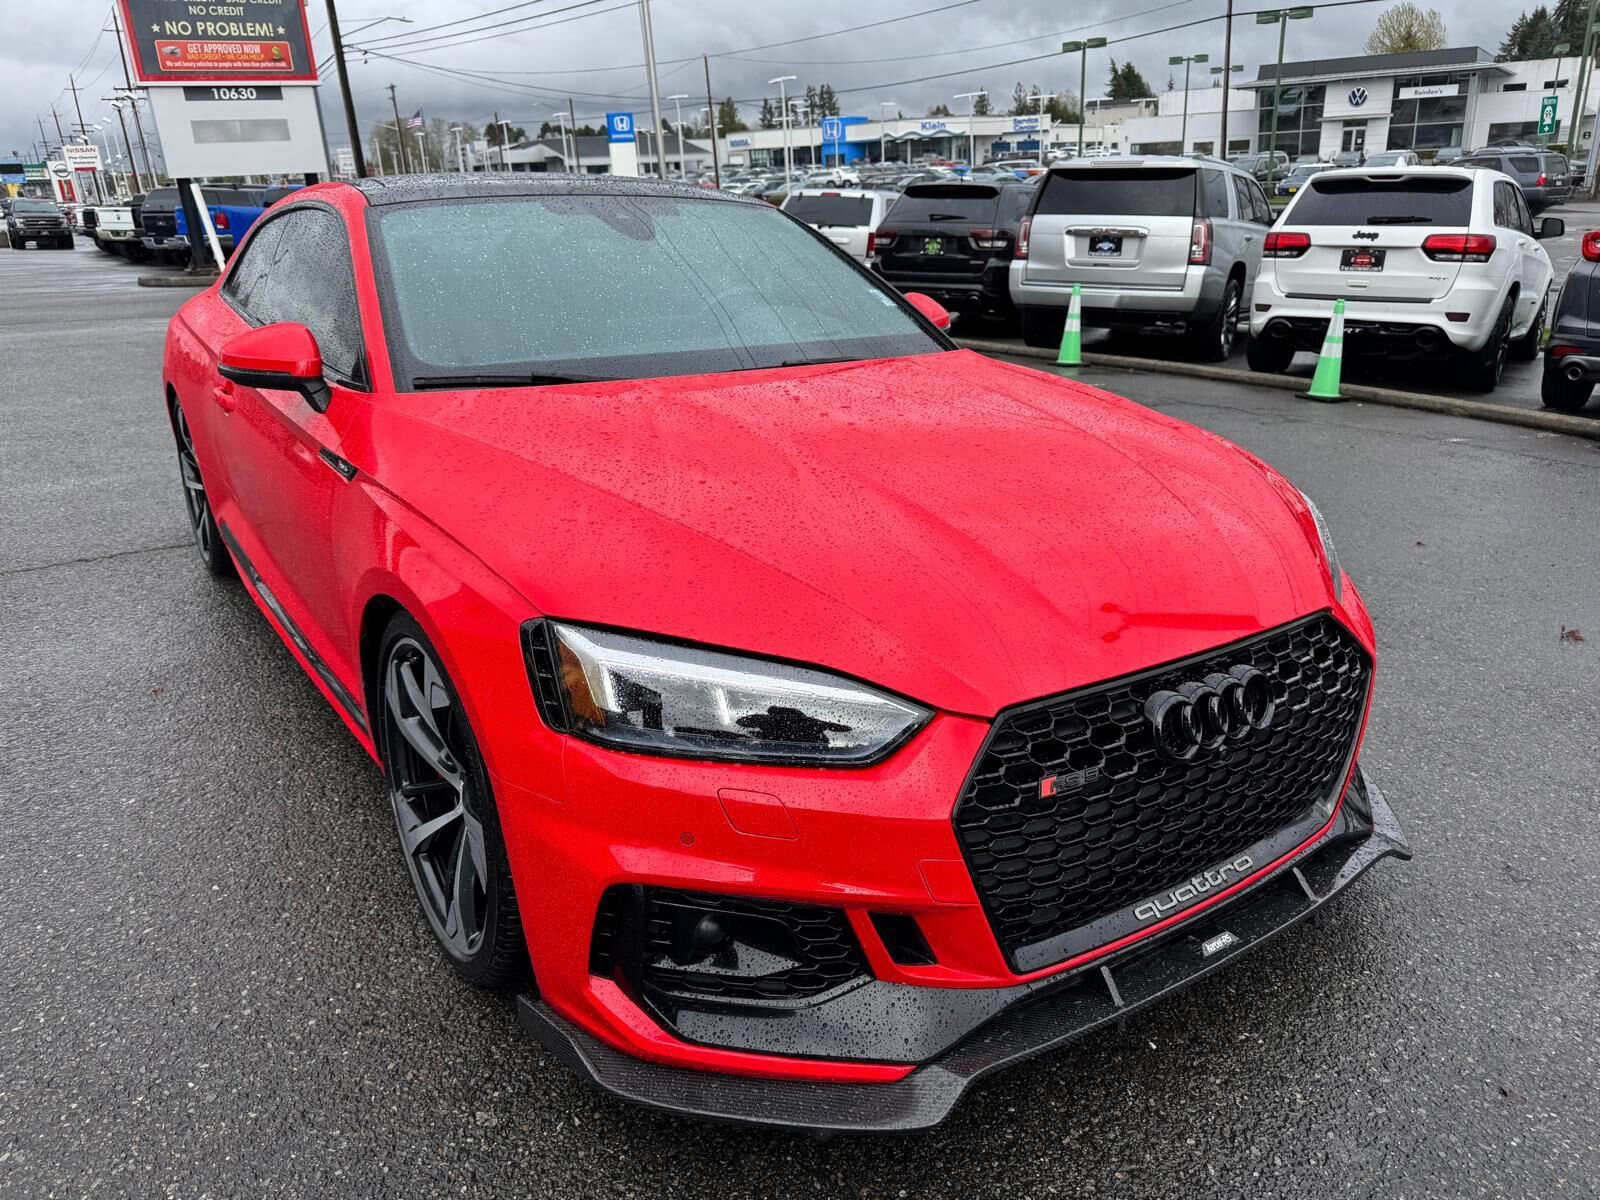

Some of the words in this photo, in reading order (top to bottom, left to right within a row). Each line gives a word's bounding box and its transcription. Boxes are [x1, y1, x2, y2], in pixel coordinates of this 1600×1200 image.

[188, 6, 206, 15] NO
[209, 6, 244, 16] CREDIT
[164, 21, 192, 35] NO
[196, 22, 274, 36] PROBLEM!
[187, 43, 202, 54] GET
[203, 43, 243, 54] APPROVED
[243, 43, 261, 54] NOW
[211, 88, 257, 100] 10630
[920, 122, 946, 131] Klein
[1352, 230, 1379, 242] Jeep
[1134, 855, 1253, 920] quattro
